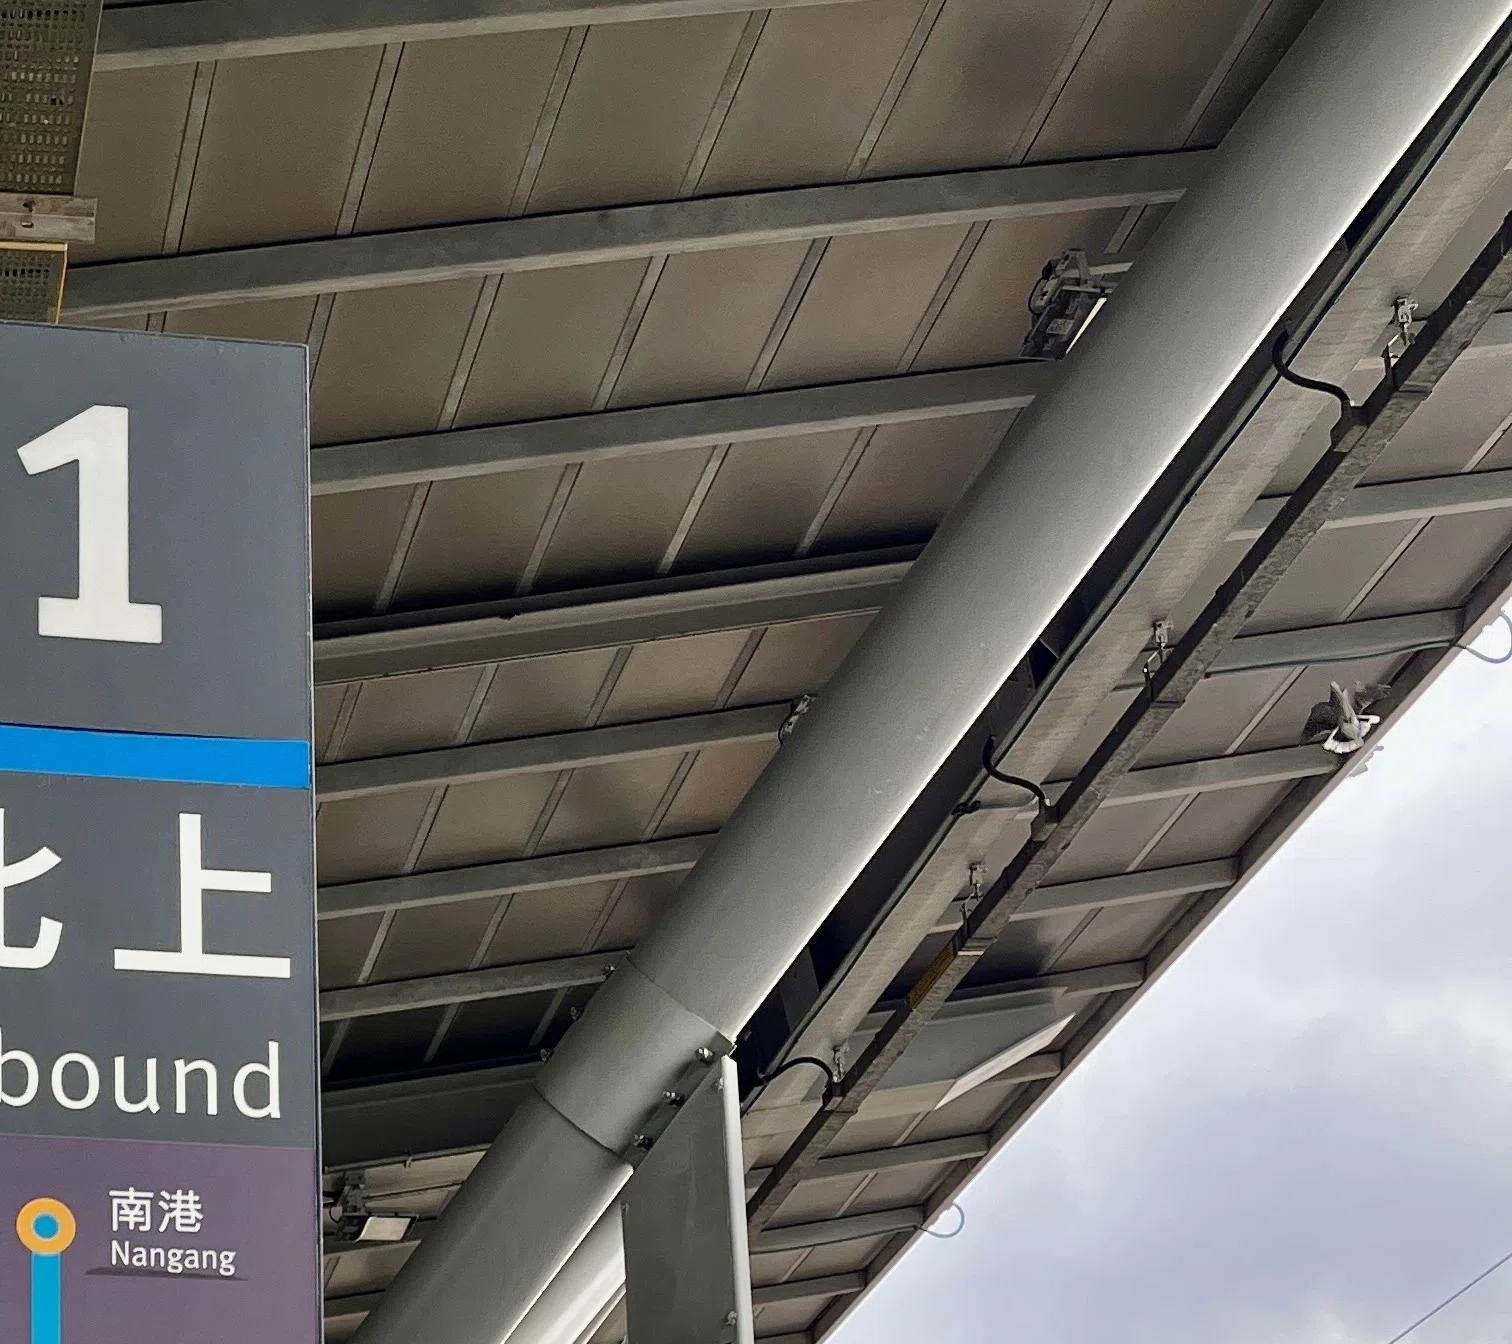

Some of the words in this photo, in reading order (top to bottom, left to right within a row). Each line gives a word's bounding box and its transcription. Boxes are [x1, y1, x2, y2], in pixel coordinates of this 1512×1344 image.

[16, 404, 163, 644] 1
[108, 1186, 204, 1233] 南港
[110, 1239, 237, 1276] Nangang
